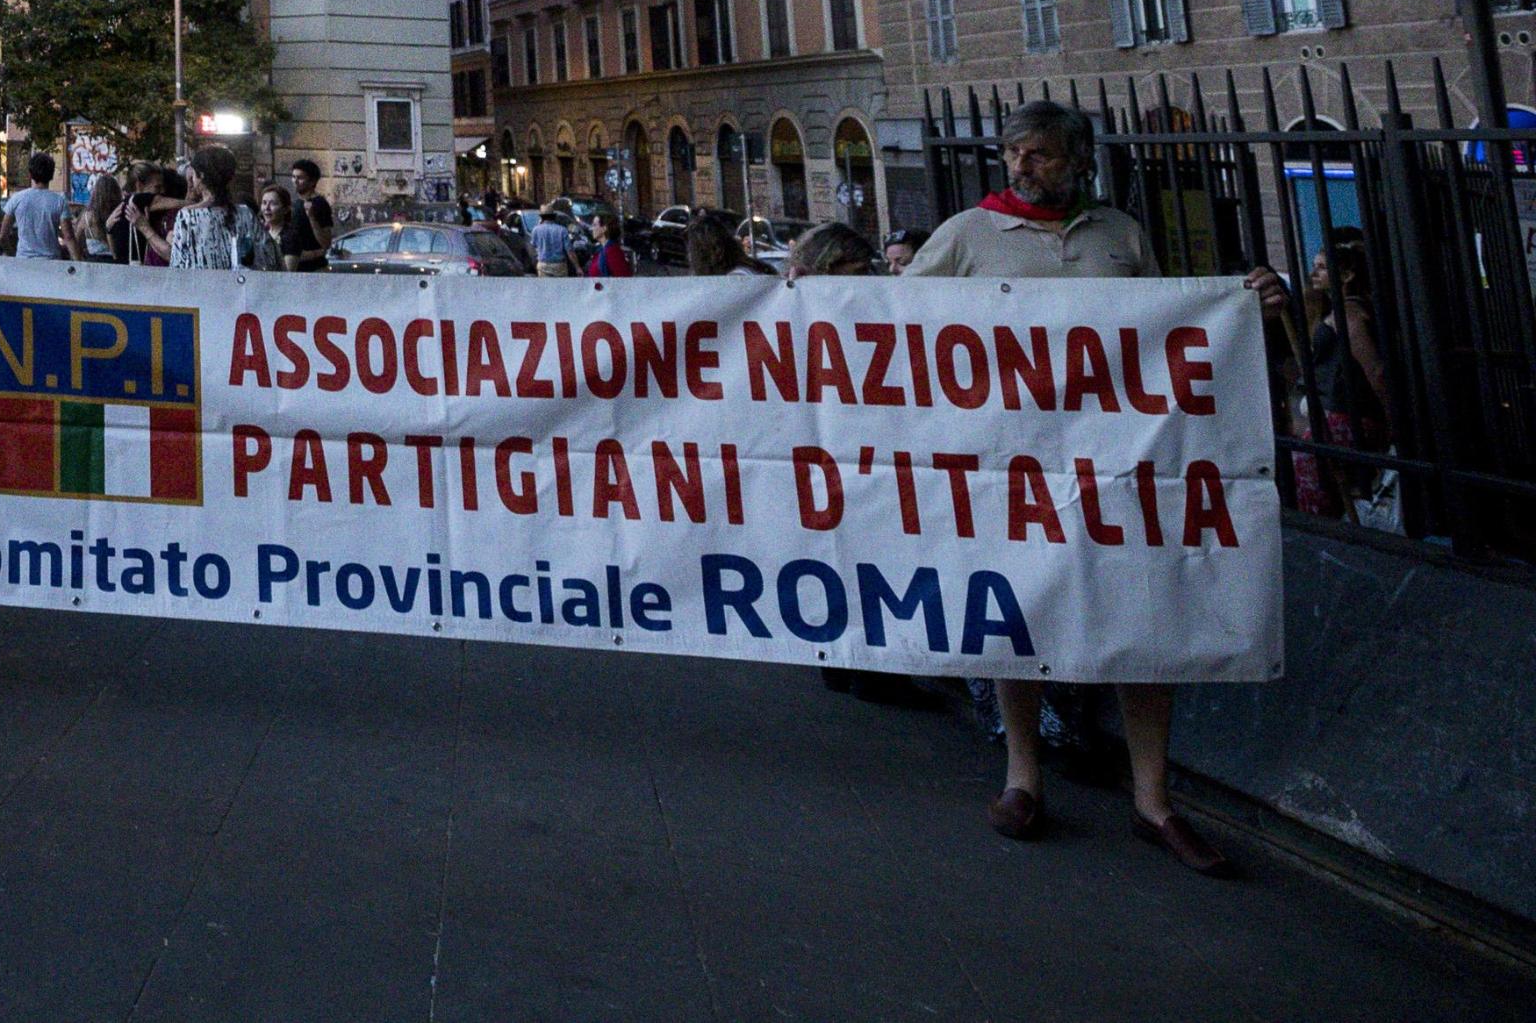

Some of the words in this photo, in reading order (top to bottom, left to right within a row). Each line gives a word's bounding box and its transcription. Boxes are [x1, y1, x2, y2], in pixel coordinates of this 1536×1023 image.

[228, 313, 724, 401] ASSOCIAZIONE
[742, 320, 1218, 416] NAZIONALE
[232, 424, 745, 526] PARTIGIANI
[791, 445, 1240, 549] D'ITALIA
[258, 543, 673, 632] Provinciale
[700, 553, 1037, 657] ROMA
